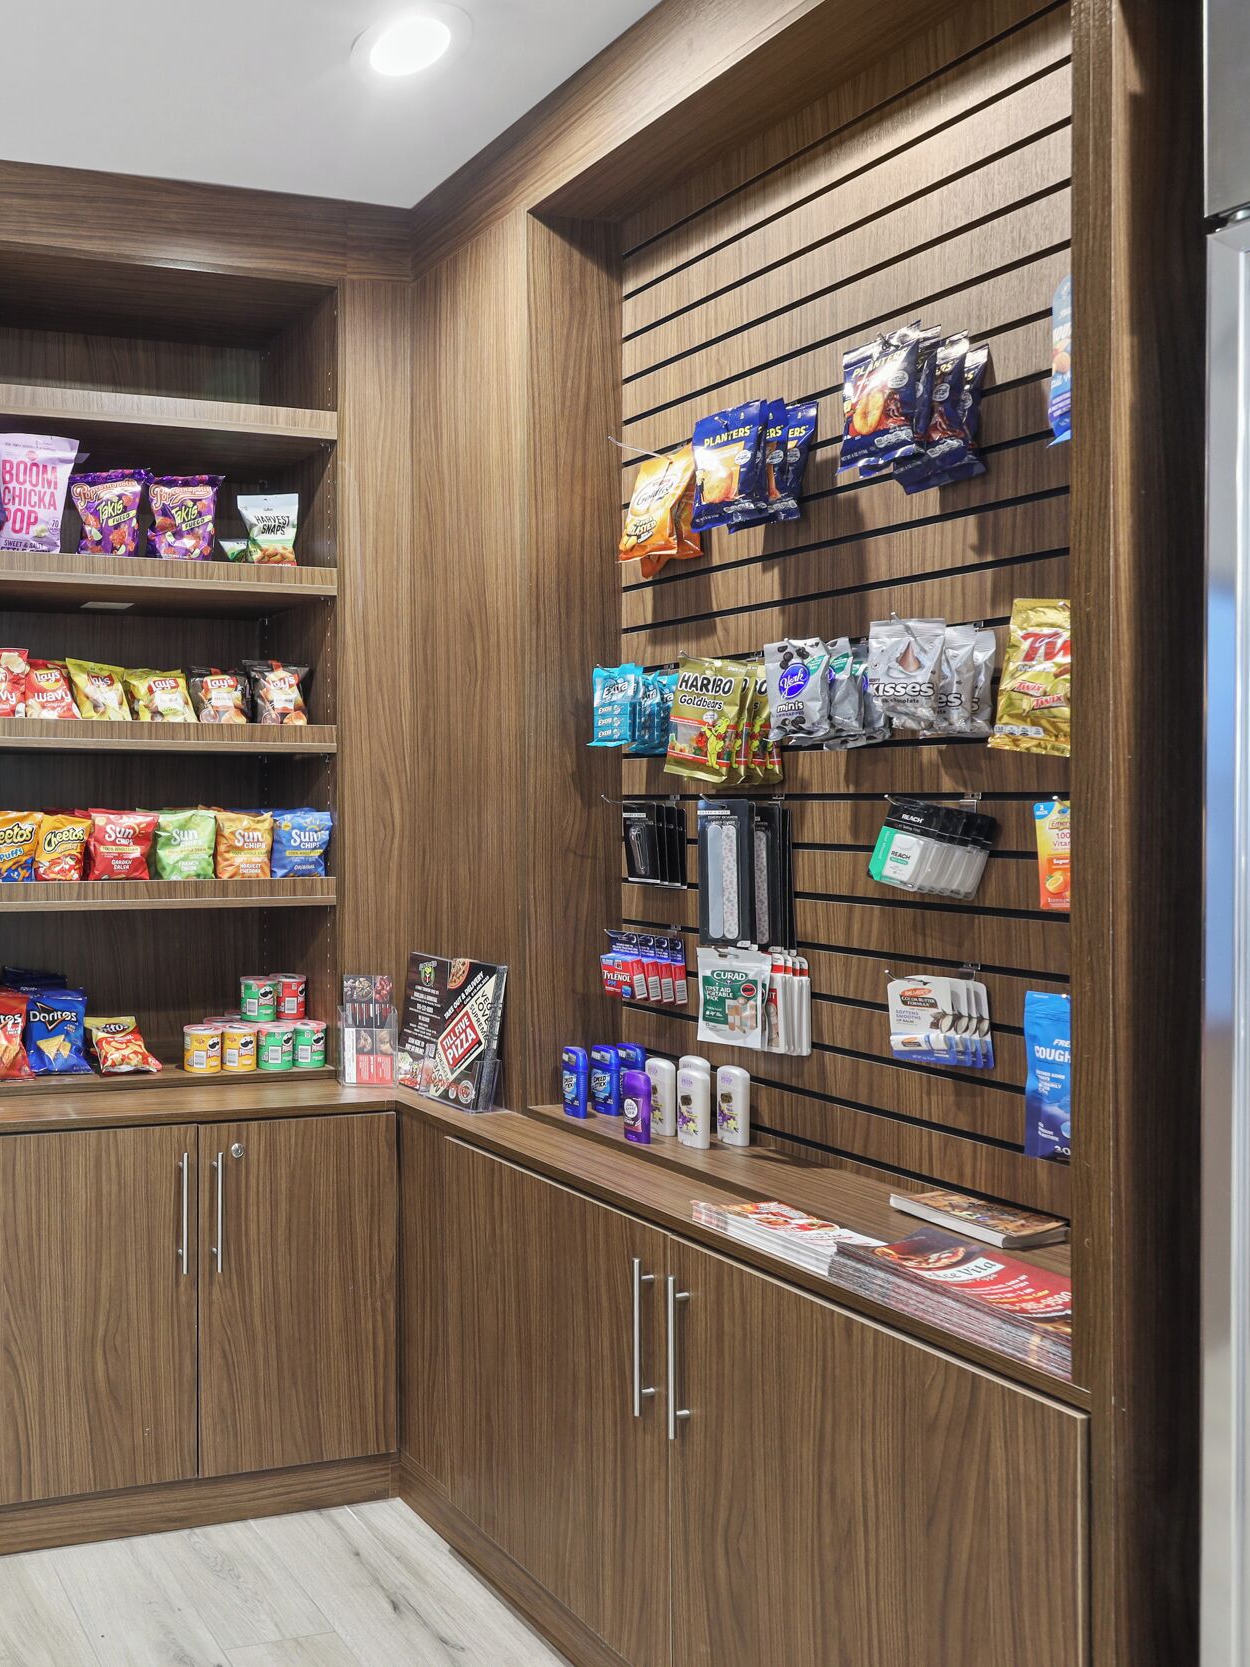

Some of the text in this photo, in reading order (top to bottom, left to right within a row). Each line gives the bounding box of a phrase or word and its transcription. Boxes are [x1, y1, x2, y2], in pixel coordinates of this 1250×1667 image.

[704, 425, 751, 448] PLANTERS
[1, 459, 58, 490] BOOM
[2, 486, 57, 511] CHICKA
[97, 500, 124, 524] Takis
[112, 513, 130, 524] FUEGO
[171, 505, 198, 527] Takis
[185, 518, 205, 529] FUEGO
[254, 515, 290, 527] HARVEST
[261, 524, 286, 536] SNAPS
[4, 540, 23, 548] SWEET
[29, 541, 44, 550] SALTY
[35, 670, 60, 683] Lay's
[207, 677, 235, 689] Lay's
[679, 672, 734, 696] HARIBO
[780, 668, 807, 699] York
[153, 679, 177, 692] Lay's
[34, 690, 72, 704] wavy
[679, 694, 723, 711] Goldbears
[777, 701, 804, 713] minis
[902, 813, 923, 824] REACH
[44, 828, 85, 853] Cheetos
[105, 824, 134, 842] Sun
[171, 829, 199, 845] Sun
[234, 830, 263, 847] Sun
[291, 830, 318, 846] Sun
[891, 850, 911, 860] REACH
[464, 971, 484, 996] DELIVERY
[602, 970, 631, 983] TYLENOL
[713, 971, 746, 981] CURAD
[30, 1010, 78, 1022] Doritos
[443, 1032, 457, 1050] TILL
[454, 1015, 470, 1037] FIVE
[446, 1027, 476, 1065] PIZZA
[1034, 1046, 1070, 1063] COUGH
[960, 1260, 997, 1276] Vita
